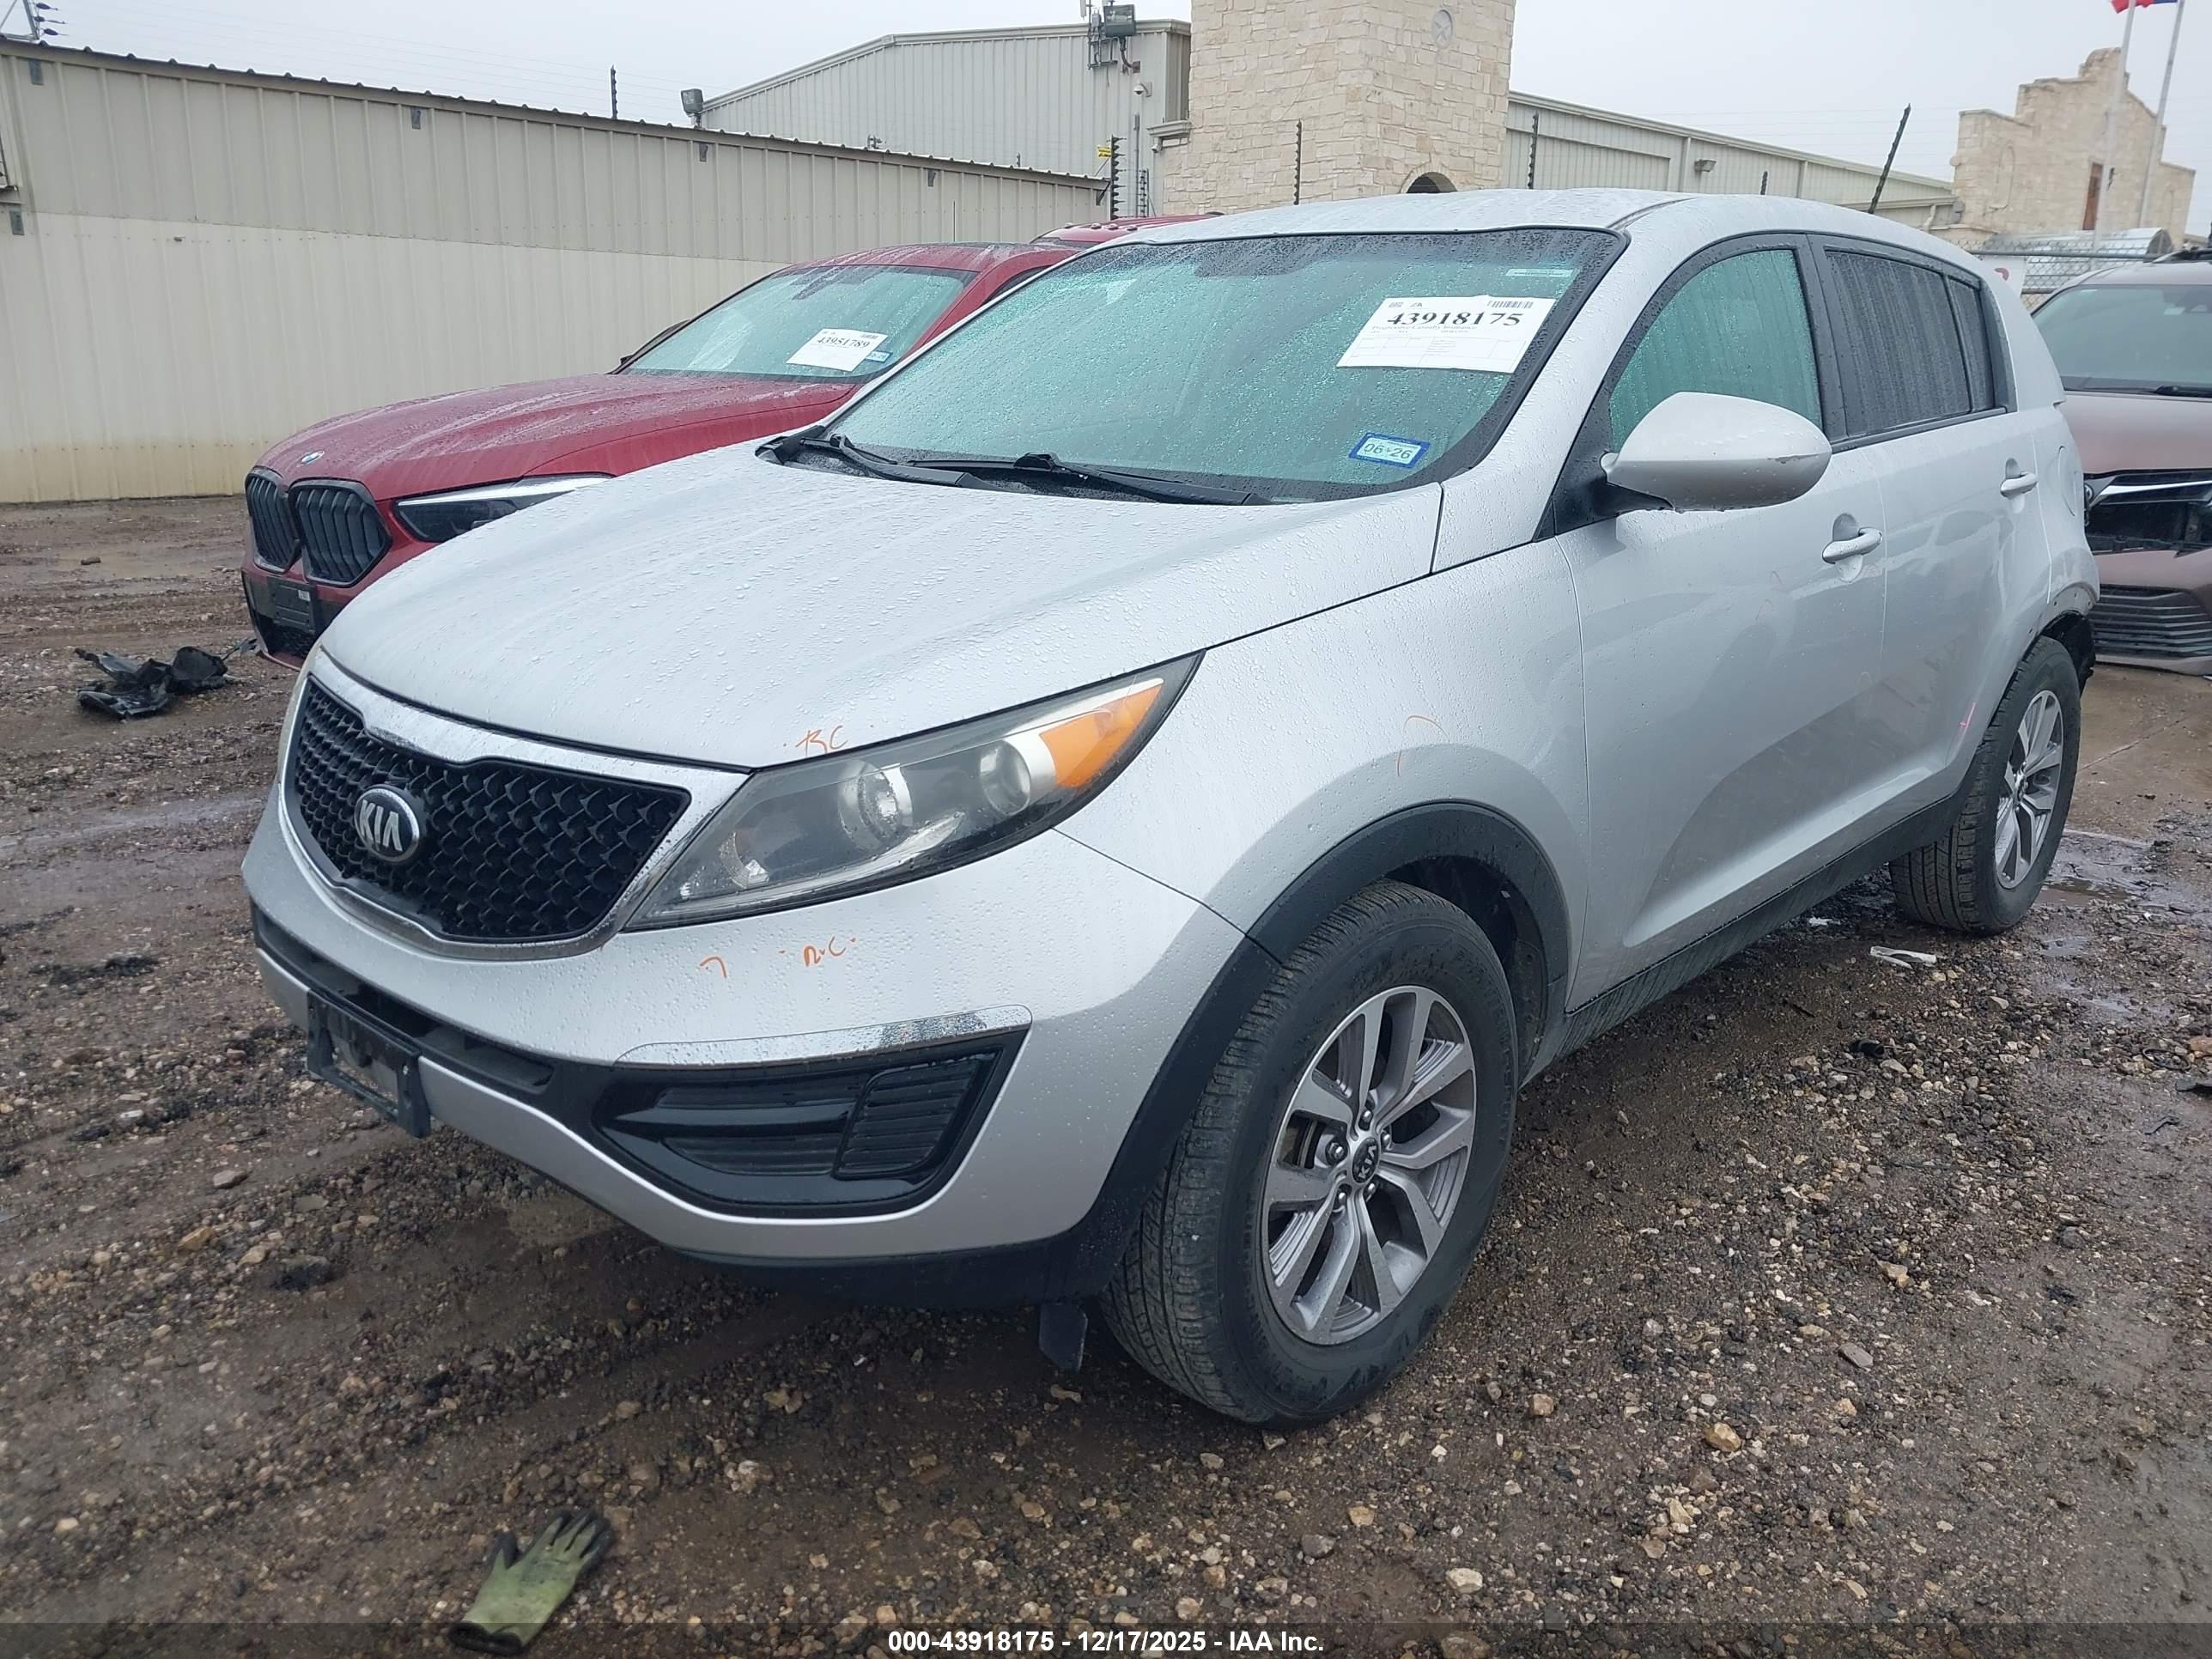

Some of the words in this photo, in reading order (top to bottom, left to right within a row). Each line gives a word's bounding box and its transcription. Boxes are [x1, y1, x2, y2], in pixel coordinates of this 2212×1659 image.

[1387, 312, 1524, 326] 43918175
[817, 337, 871, 348] 43951789
[359, 799, 404, 852] KIA
[1357, 1145, 1377, 1180] KIA
